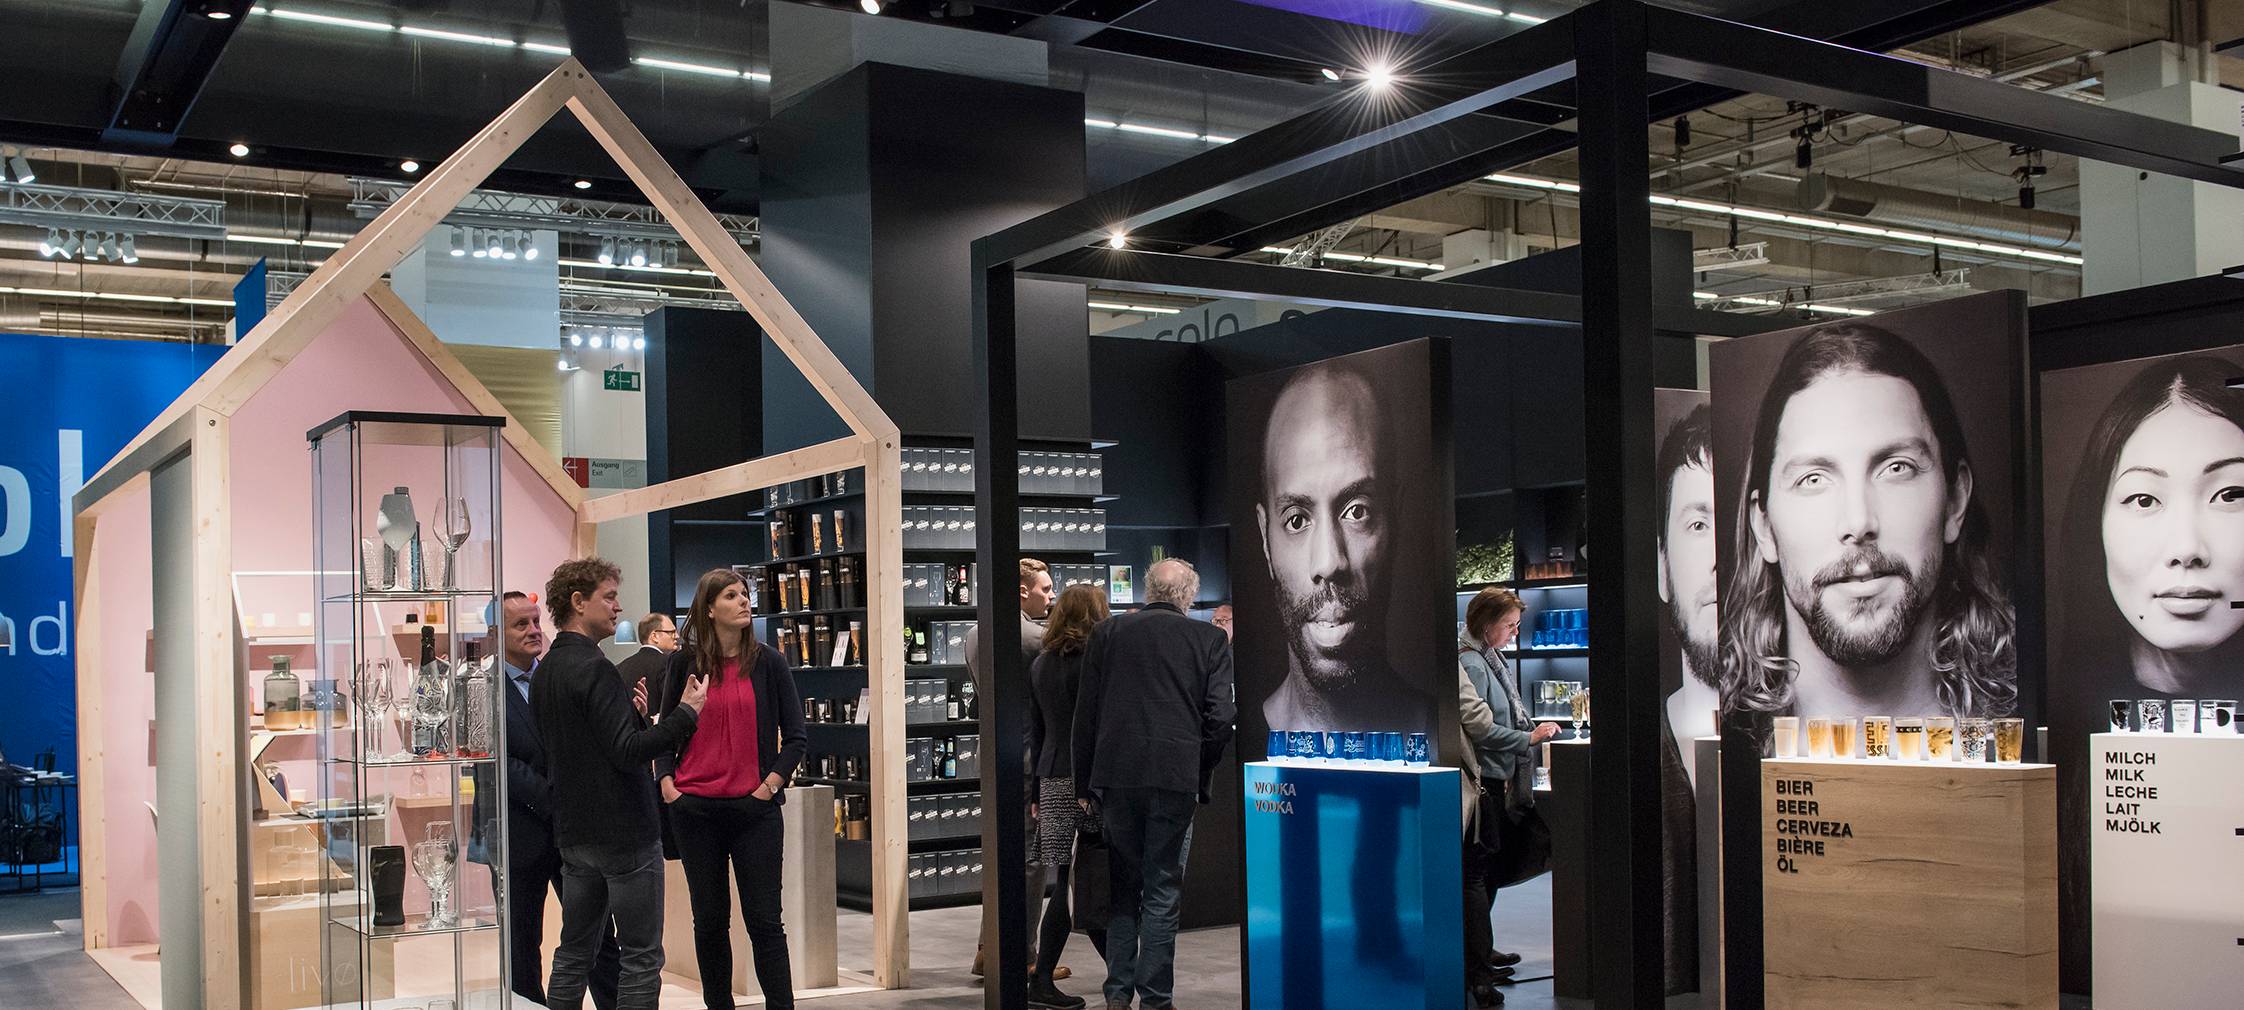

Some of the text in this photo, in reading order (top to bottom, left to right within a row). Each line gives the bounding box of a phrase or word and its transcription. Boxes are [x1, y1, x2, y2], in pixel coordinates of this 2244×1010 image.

[592, 461, 620, 469] Ausgang
[2105, 751, 2156, 765] MILCH
[2105, 768, 2145, 782] MILK
[1254, 781, 1297, 797] WODKA
[1776, 779, 1813, 796] BIER
[2105, 785, 2158, 799] LECHE
[1255, 799, 1294, 815] VODKA
[1776, 799, 1819, 816] BEER
[2105, 802, 2141, 816] LAIT
[1776, 818, 1853, 839] CERVEZA
[2105, 817, 2161, 834] MJÖLK
[1776, 835, 1825, 857] BIÈRE
[1776, 854, 1798, 873] ÖL
